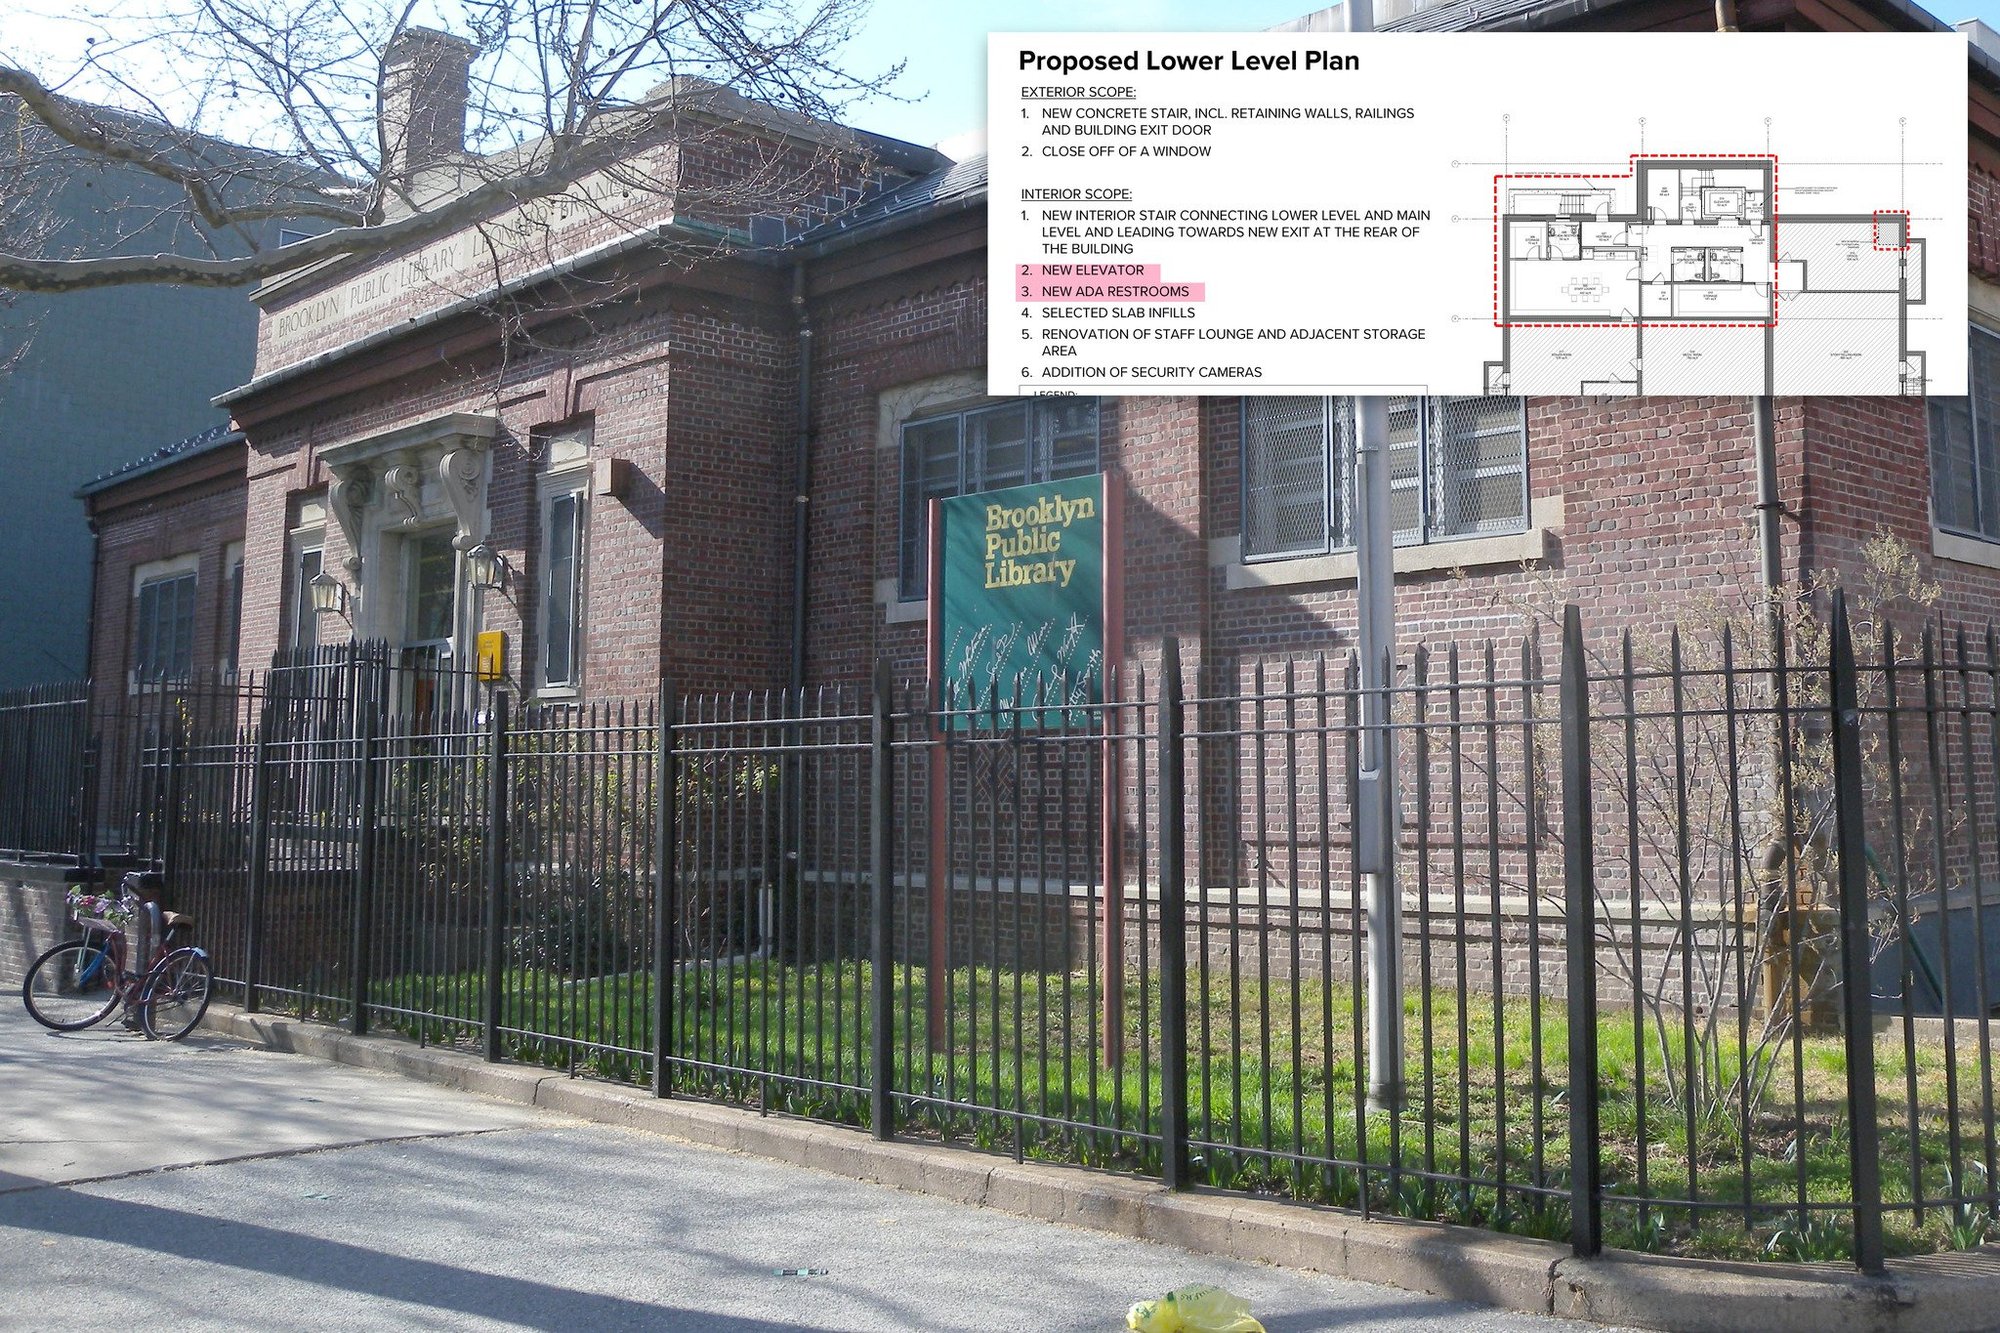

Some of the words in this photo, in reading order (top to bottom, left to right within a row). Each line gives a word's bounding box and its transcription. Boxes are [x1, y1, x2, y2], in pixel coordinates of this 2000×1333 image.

[278, 293, 339, 338] BROOKLYN
[350, 272, 392, 309] PUBLIC
[400, 244, 457, 288] LIBRARY
[985, 494, 1095, 532] Brooklyn
[985, 526, 1061, 560] Public
[984, 558, 1076, 589] Library
